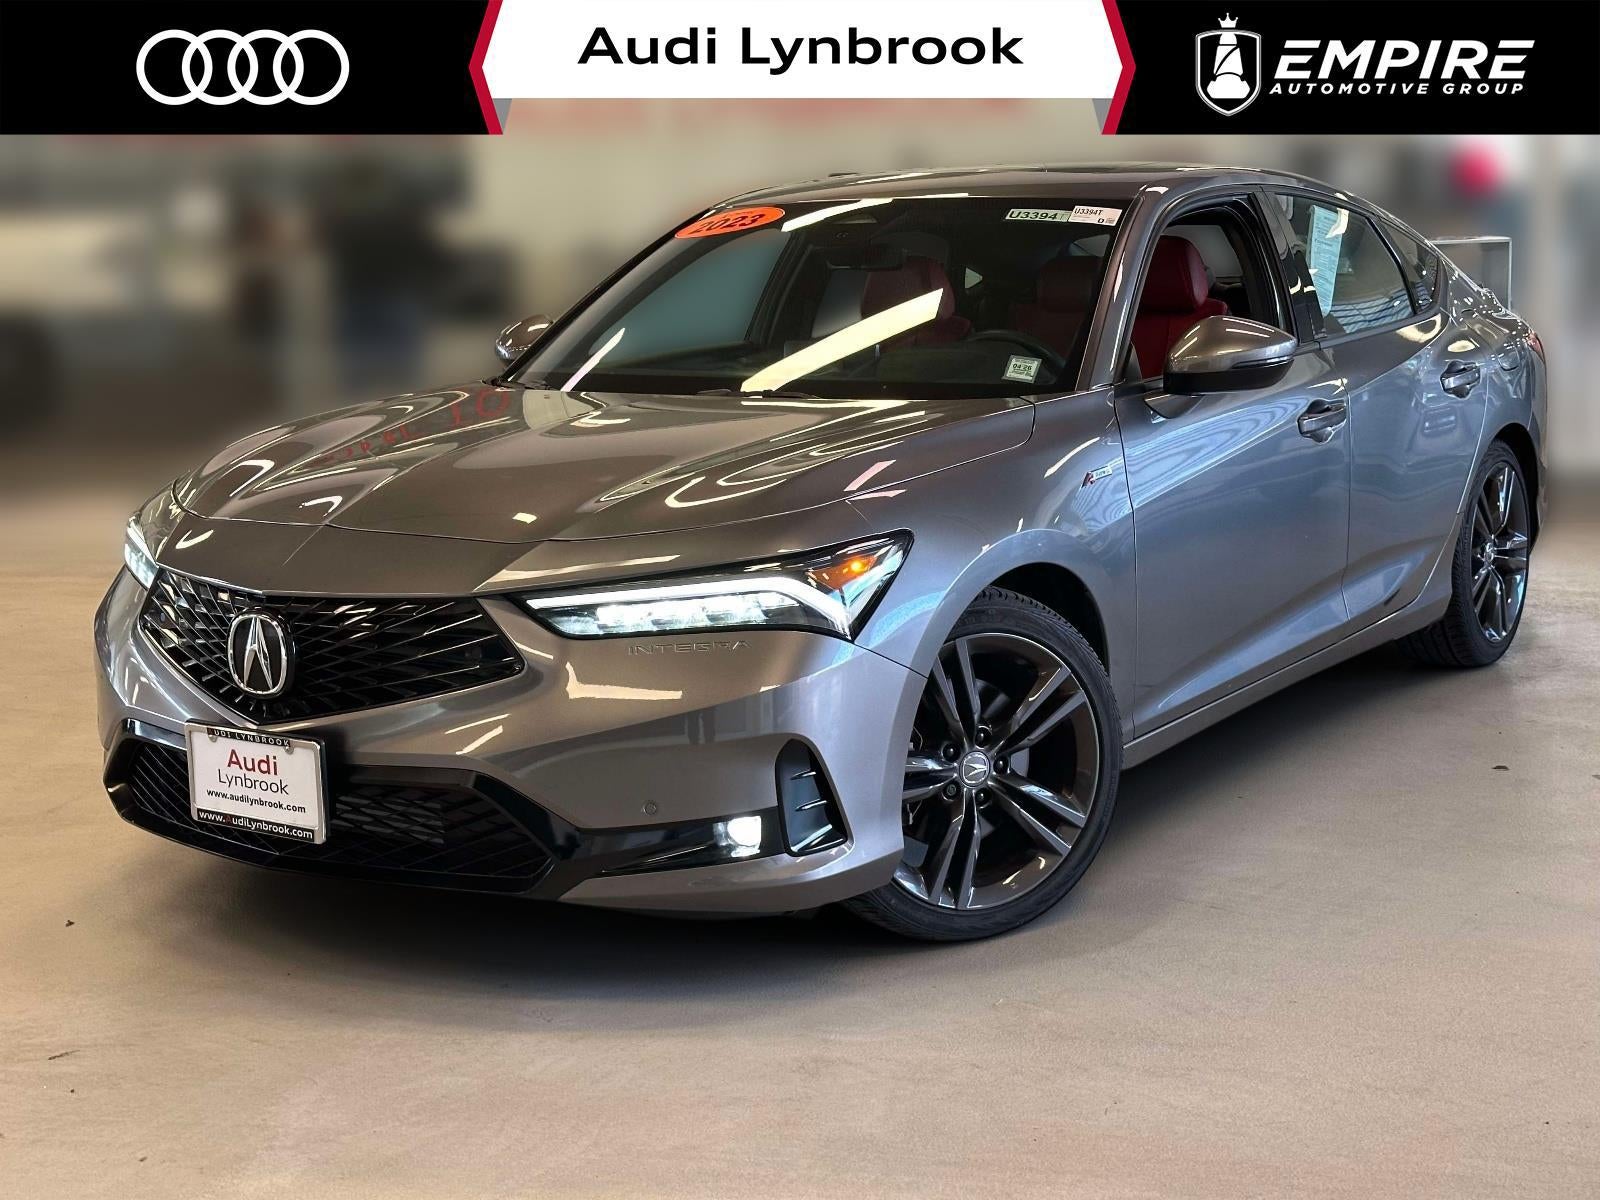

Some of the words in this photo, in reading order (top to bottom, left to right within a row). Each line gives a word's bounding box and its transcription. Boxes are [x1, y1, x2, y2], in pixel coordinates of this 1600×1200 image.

[687, 213, 766, 235] 2023
[627, 640, 751, 656] INTEGRA
[235, 732, 290, 746] LYNBROOK
[227, 749, 278, 776] Audi
[217, 768, 289, 795] Lynbrook
[206, 788, 306, 814] www.audilynbrook.com
[198, 809, 313, 839] www.AudiLynbrook.com
